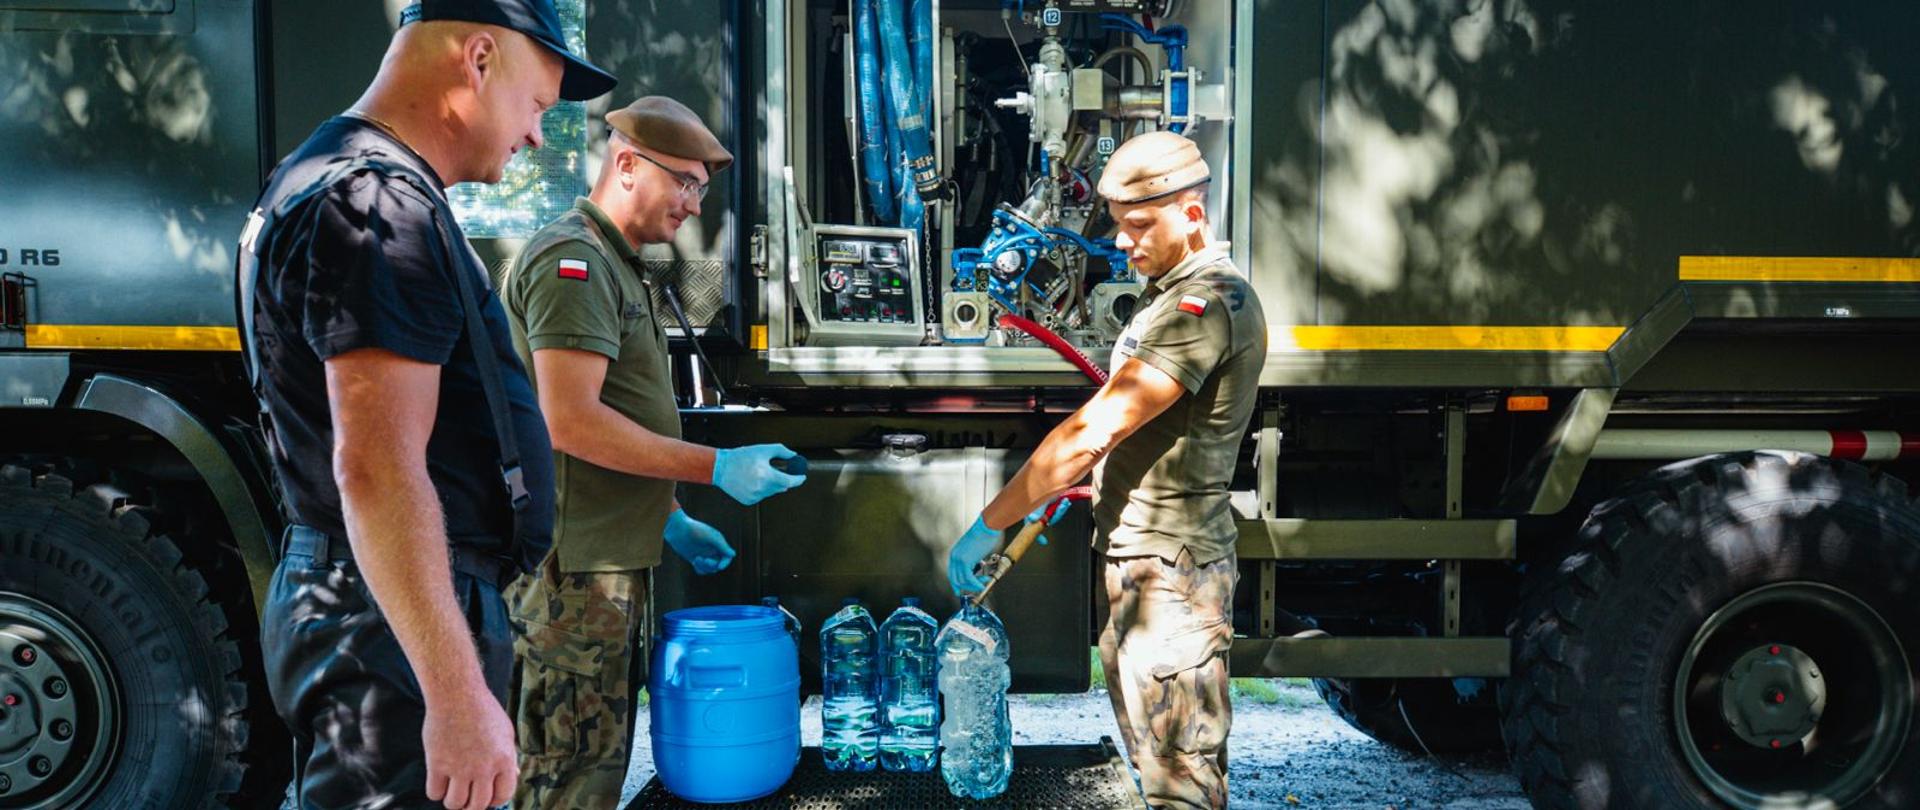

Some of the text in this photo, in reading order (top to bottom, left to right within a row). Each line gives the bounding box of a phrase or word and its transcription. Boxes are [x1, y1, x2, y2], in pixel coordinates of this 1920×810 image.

[1047, 12, 1058, 22] 12
[1100, 140, 1111, 151] 13
[21, 248, 60, 266] R6
